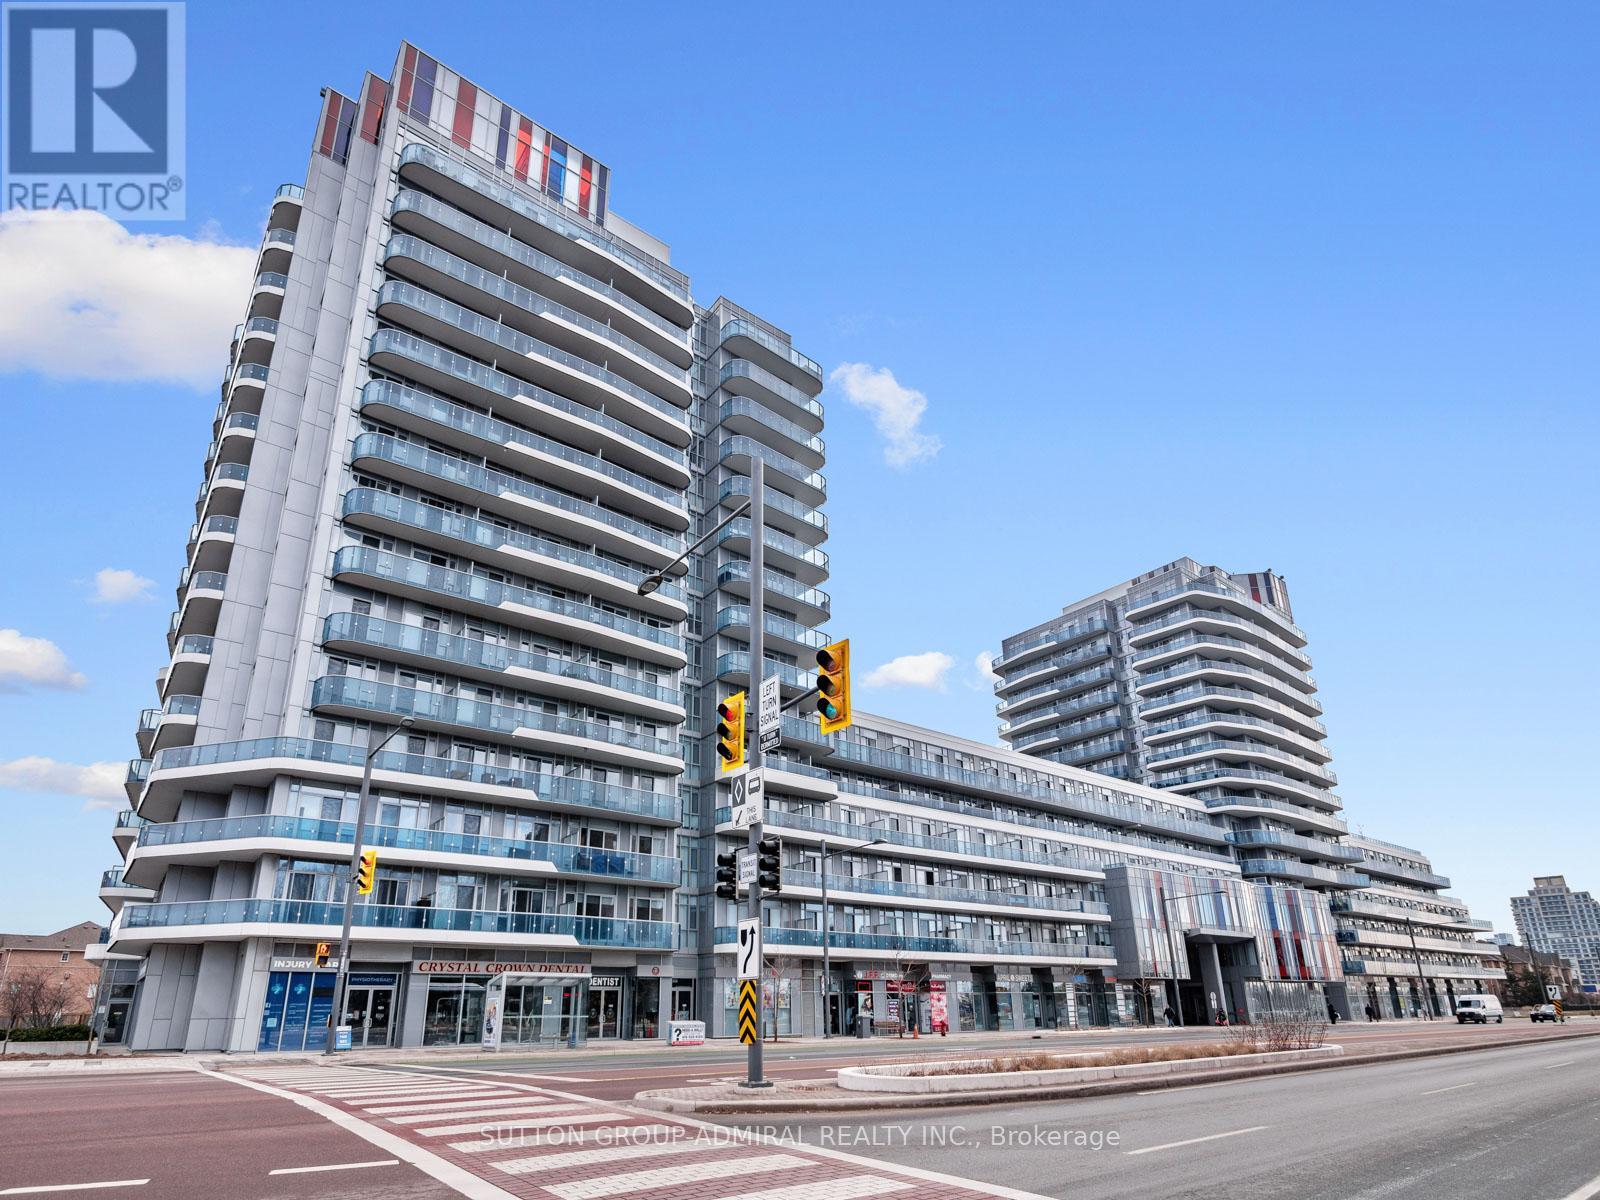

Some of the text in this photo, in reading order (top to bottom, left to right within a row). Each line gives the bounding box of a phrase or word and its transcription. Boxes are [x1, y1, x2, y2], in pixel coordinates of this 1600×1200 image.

[762, 681, 776, 698] LEFT
[762, 695, 777, 712] TURN
[760, 709, 779, 727] SIGNAL
[746, 805, 757, 815] THIS
[745, 813, 758, 824] LANE
[741, 858, 757, 869] TRANSIT
[742, 869, 756, 879] SIGNAL
[273, 960, 313, 969] INJURY
[418, 961, 587, 974] CRYSTAL CROWN DENTAL
